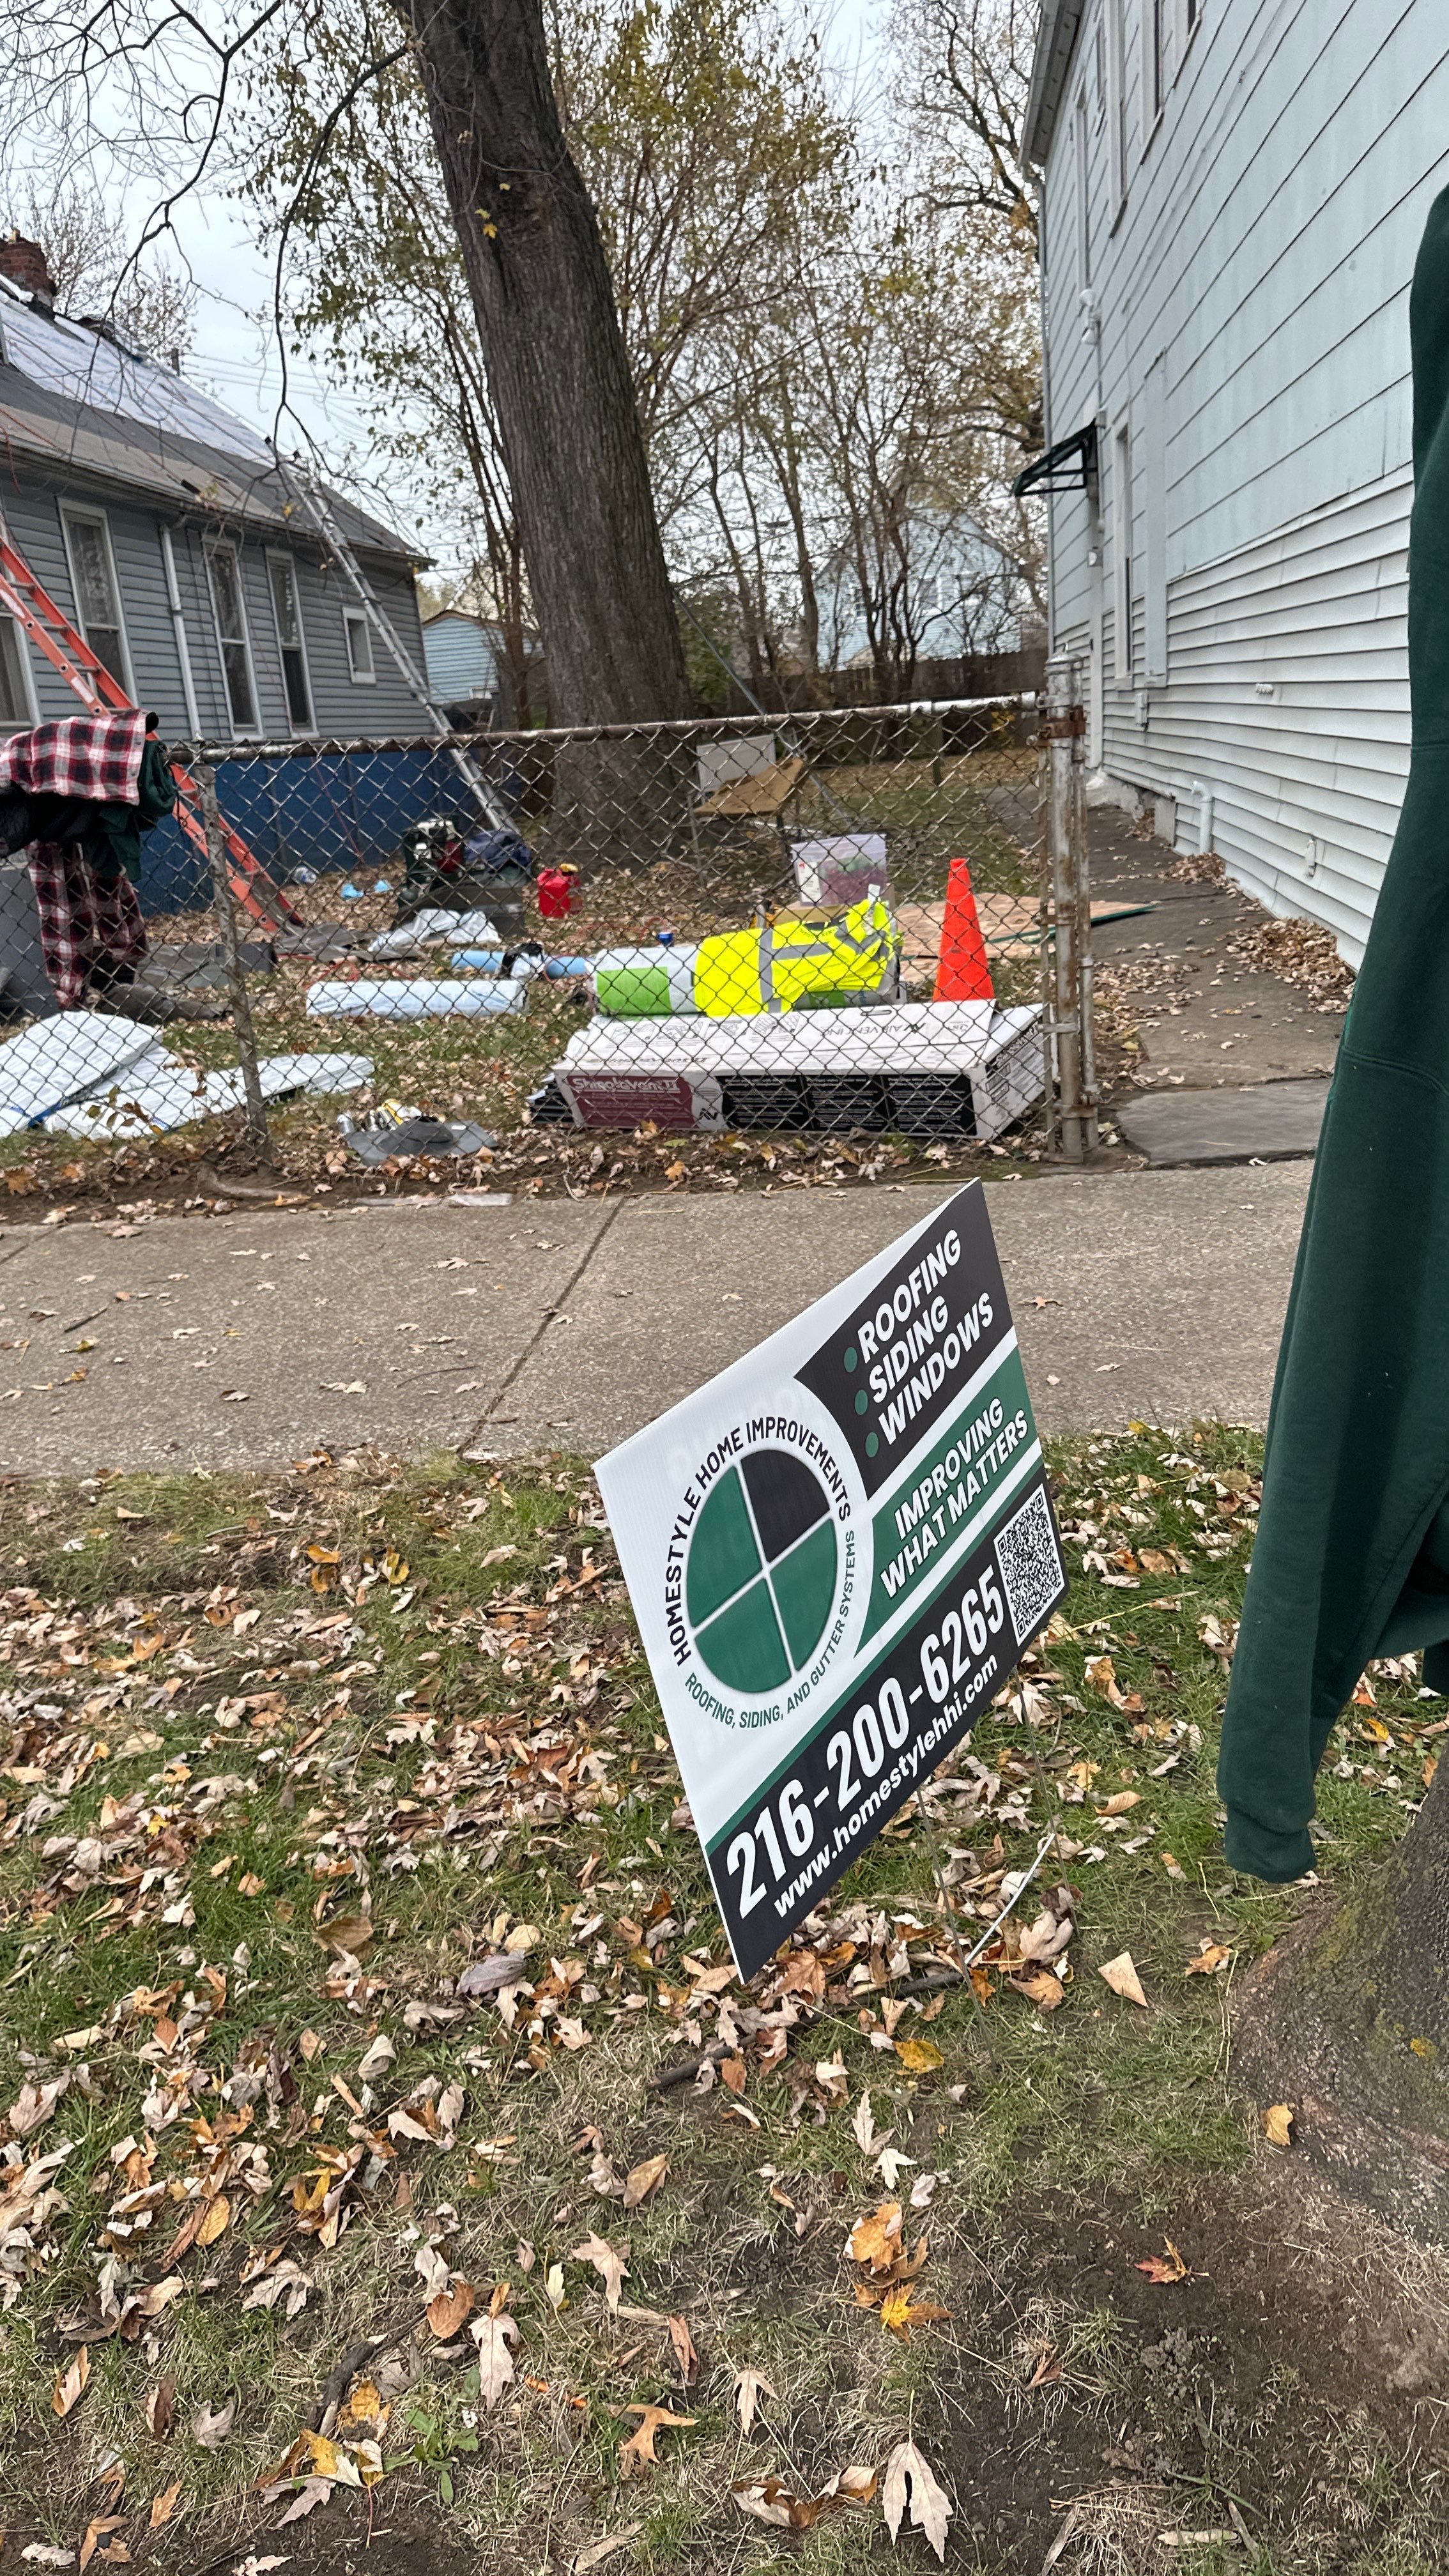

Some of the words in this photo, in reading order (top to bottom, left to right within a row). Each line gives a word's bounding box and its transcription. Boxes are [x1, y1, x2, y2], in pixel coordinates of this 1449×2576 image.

[857, 1229, 962, 1364] ROOFING
[869, 1295, 949, 1404] SIDING
[877, 1292, 993, 1446] WINDOWS
[665, 1486, 702, 1667] HOMESTYLE
[694, 1427, 744, 1491] HOME
[746, 1416, 851, 1522] IMPROVEMENTS
[879, 1504, 947, 1598] WHAT
[946, 1409, 1028, 1524] MATTERS
[894, 1398, 1004, 1541] IMPROVING
[684, 1672, 736, 1729] ROOFING,
[739, 1705, 784, 1729] SIDING,
[786, 1682, 811, 1714] AND
[810, 1618, 846, 1687] GUTTER
[839, 1529, 855, 1618] SYSTEMS
[726, 1564, 1004, 1920] 216-200-6265
[774, 1653, 999, 1919] www.homestylehhi.com
